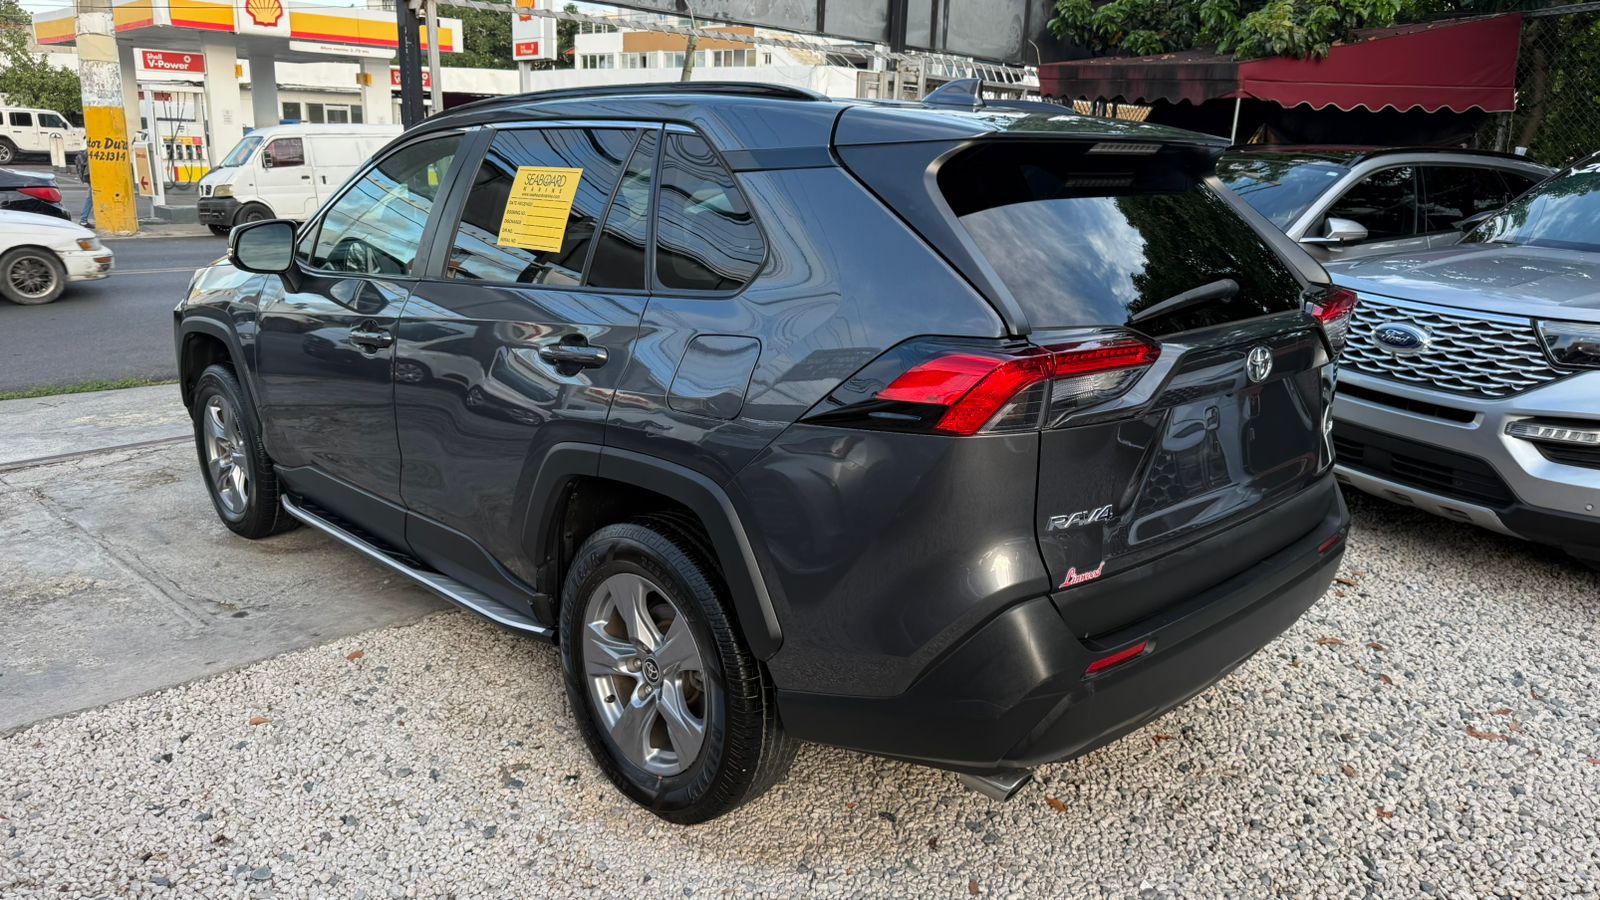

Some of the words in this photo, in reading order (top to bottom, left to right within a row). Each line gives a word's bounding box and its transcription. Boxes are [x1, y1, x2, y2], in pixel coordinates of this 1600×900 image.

[147, 59, 189, 70] V-Power
[525, 173, 567, 187] SEABOARD
[1381, 329, 1410, 344] Ford
[1046, 504, 1113, 531] RAV4
